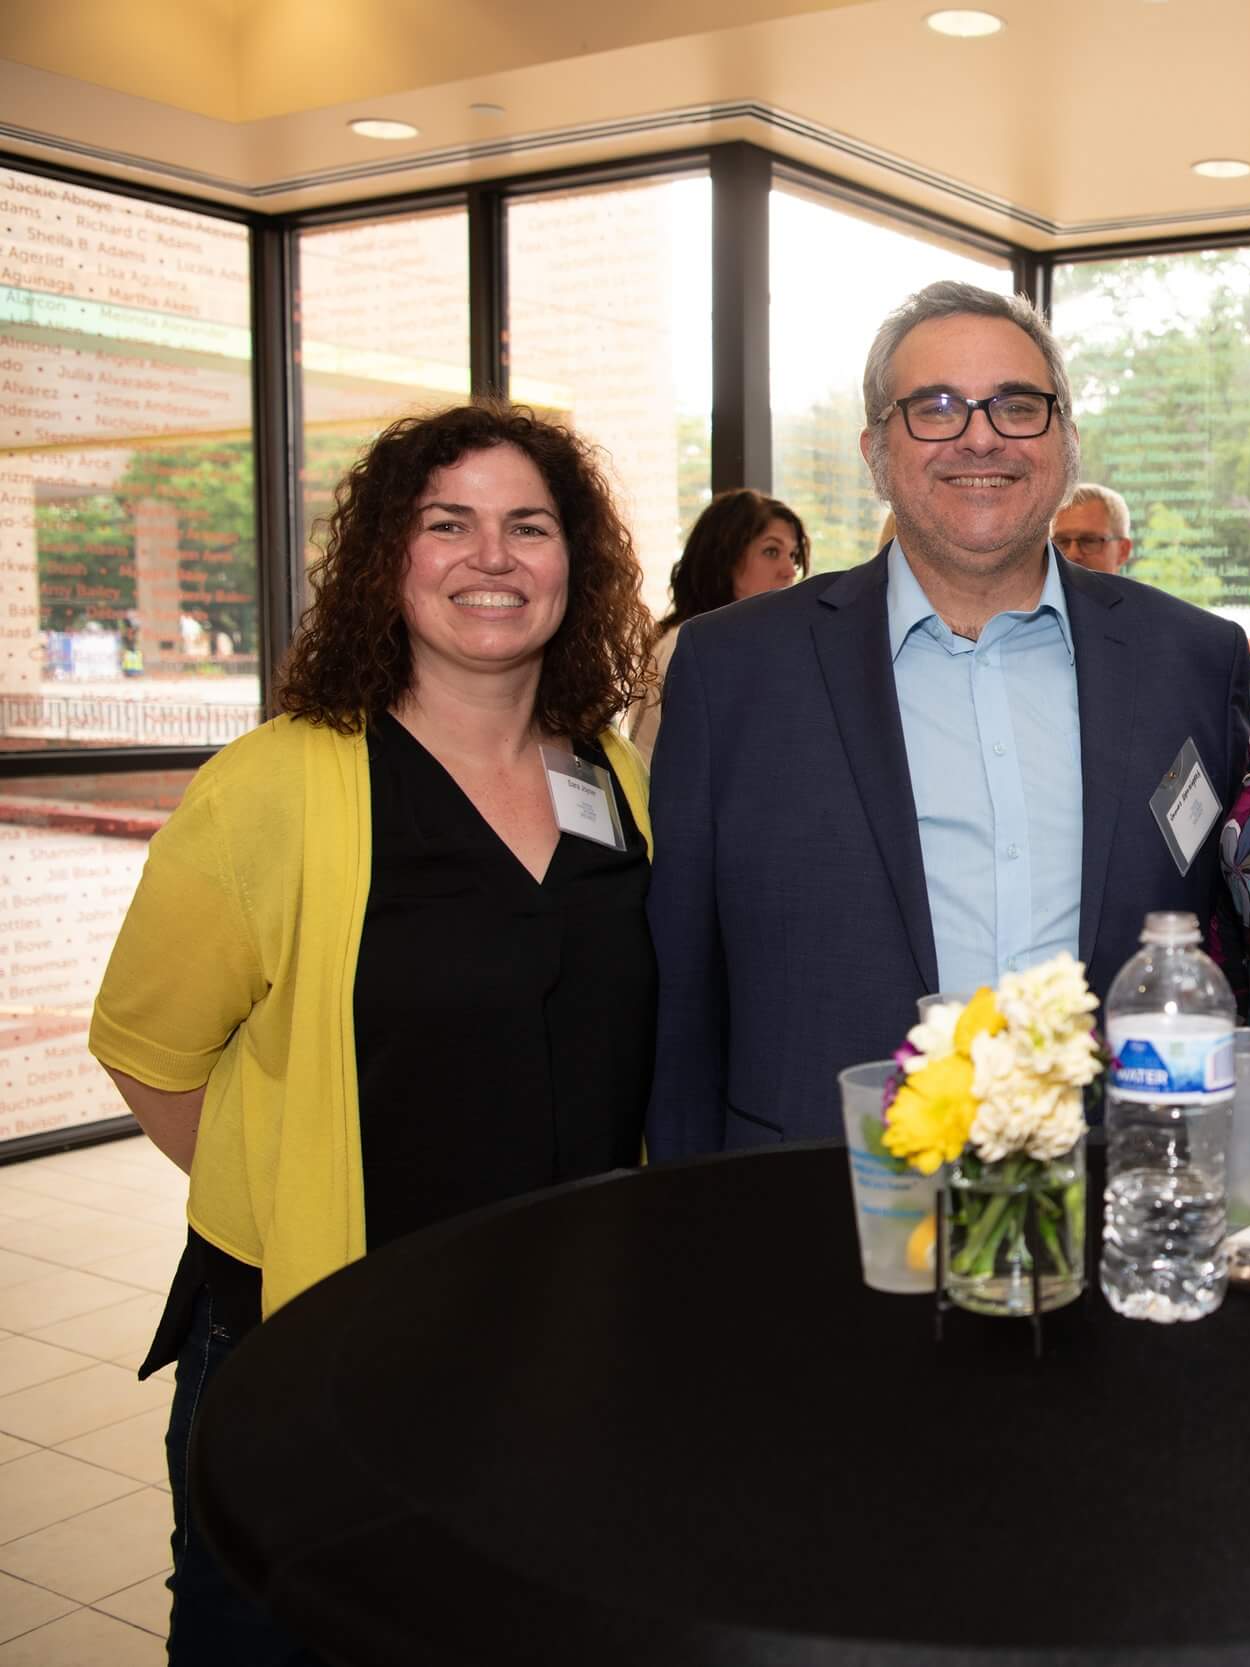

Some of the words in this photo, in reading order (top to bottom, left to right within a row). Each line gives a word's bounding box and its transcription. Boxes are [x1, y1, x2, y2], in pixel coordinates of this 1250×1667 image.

[6, 178, 57, 200] Jackie
[0, 200, 41, 219] dams
[97, 241, 145, 263] Adams
[2, 379, 58, 400] Alvarez
[0, 403, 61, 420] nderson
[1219, 565, 1249, 578] Lake
[1116, 1067, 1169, 1086] WATER
